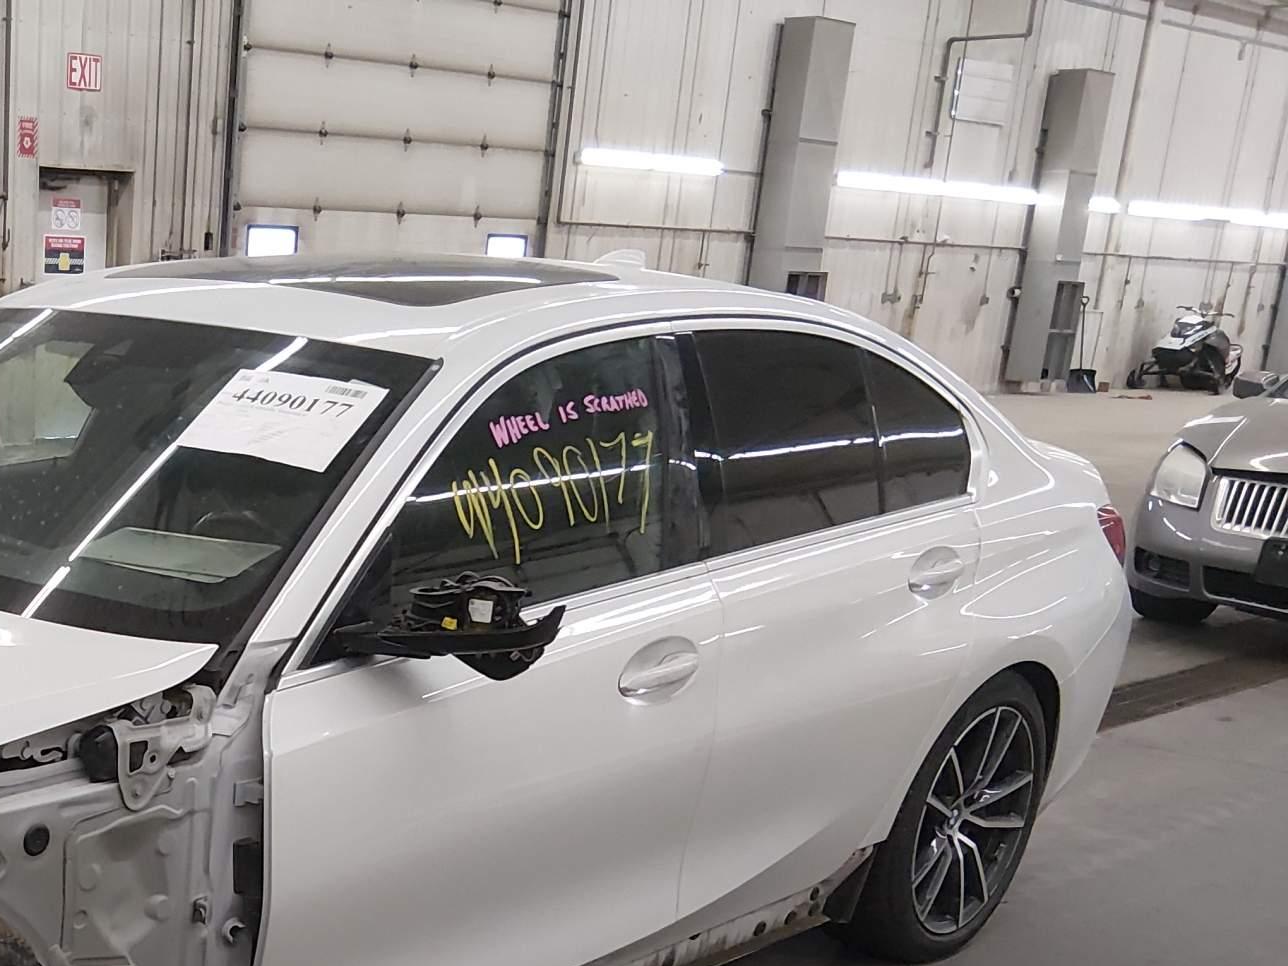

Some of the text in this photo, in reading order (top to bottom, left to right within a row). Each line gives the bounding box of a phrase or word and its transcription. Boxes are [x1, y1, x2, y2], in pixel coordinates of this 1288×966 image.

[69, 55, 100, 88] EXIT
[232, 388, 354, 418] 44090177
[489, 412, 550, 448] WHEEL
[558, 401, 579, 423] IS
